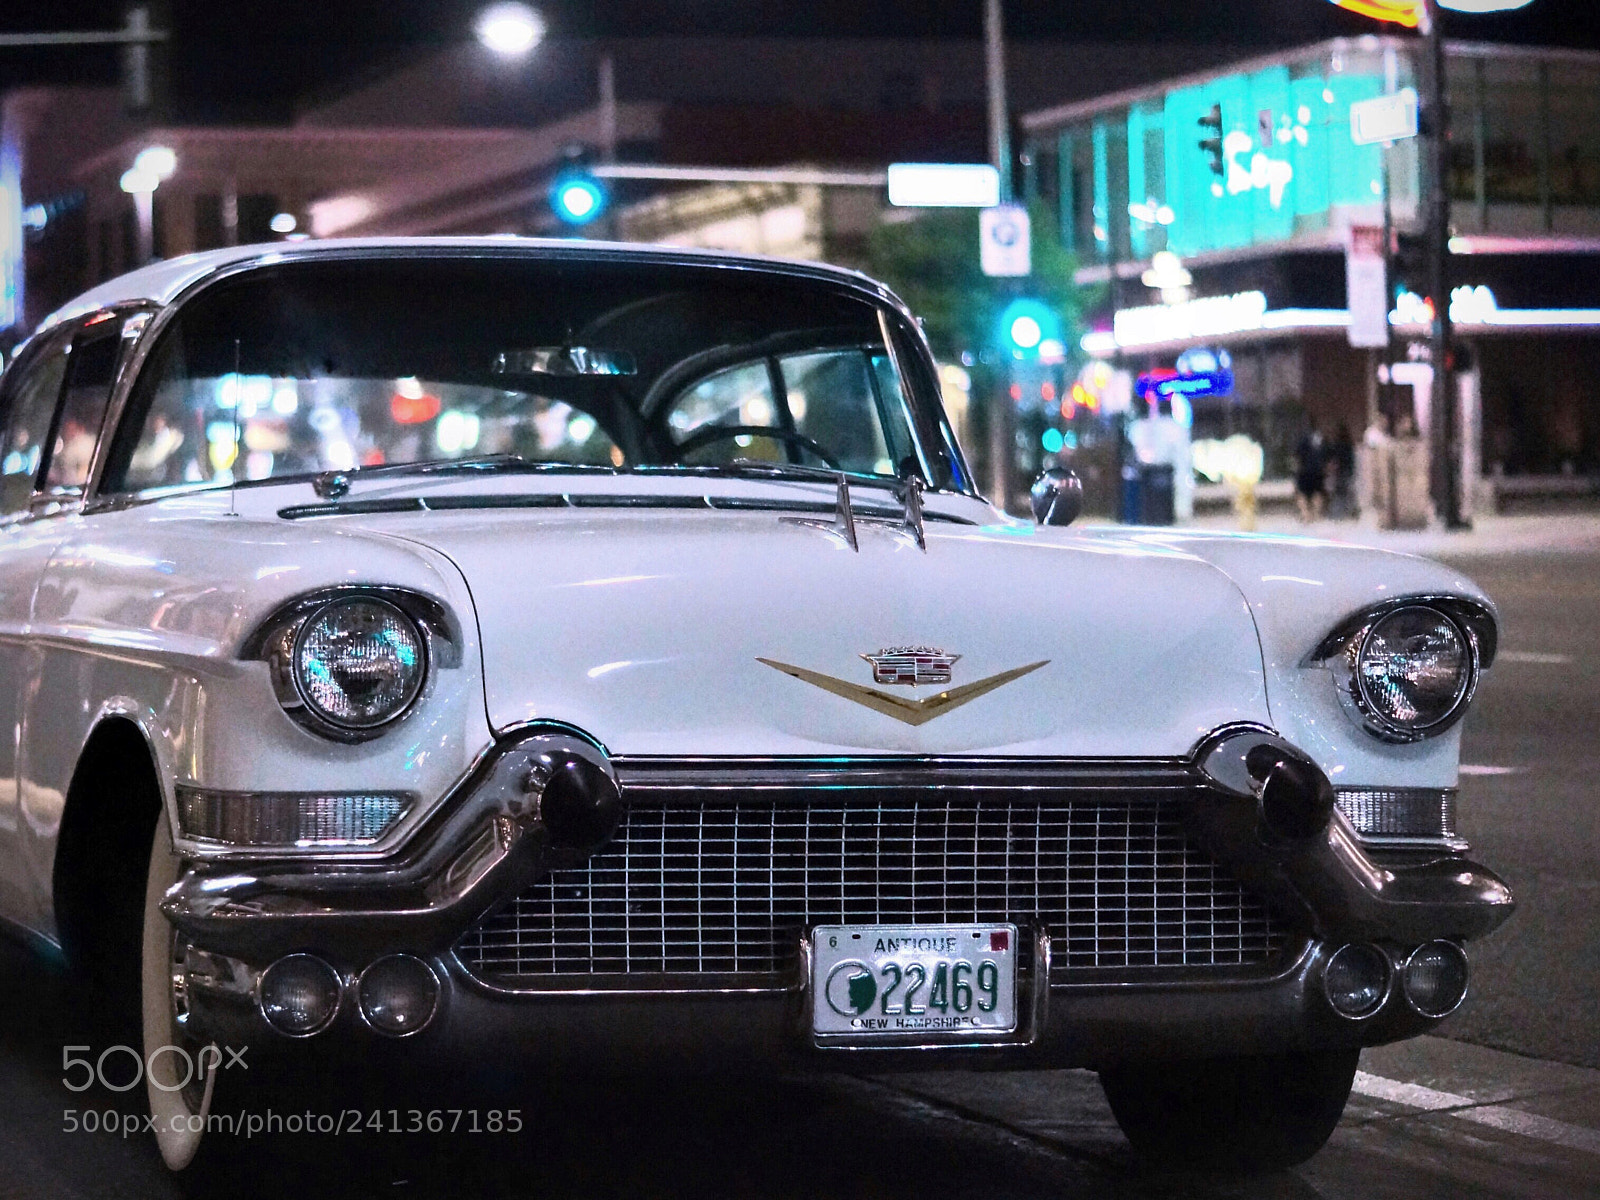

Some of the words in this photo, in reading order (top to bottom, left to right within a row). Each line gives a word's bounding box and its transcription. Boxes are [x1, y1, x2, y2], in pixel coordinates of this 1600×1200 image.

[828, 935, 838, 948] 6
[873, 937, 957, 953] ANTIQUE
[880, 960, 999, 1016] 22469
[860, 1017, 889, 1029] NEW
[896, 1016, 970, 1029] HAMPSHIRE
